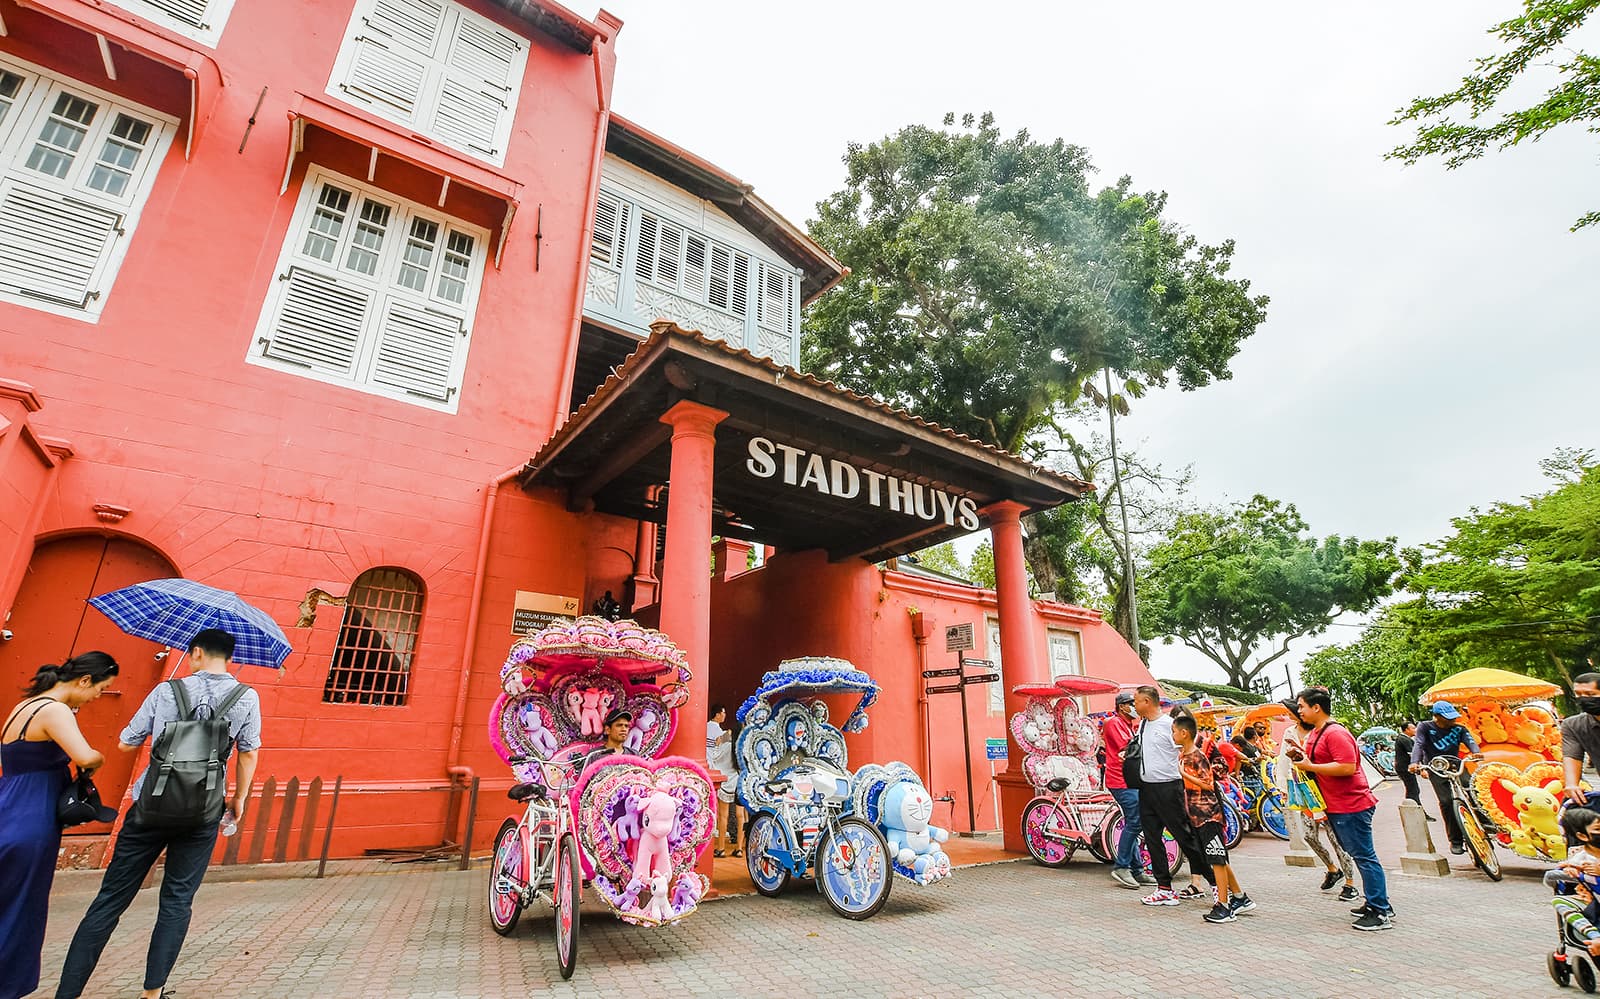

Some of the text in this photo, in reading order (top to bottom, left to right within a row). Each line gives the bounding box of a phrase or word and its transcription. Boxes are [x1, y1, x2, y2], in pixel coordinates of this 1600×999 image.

[746, 437, 980, 531] STADTHUYS
[516, 611, 539, 619] MUZIUM
[1205, 847, 1226, 856] adida
